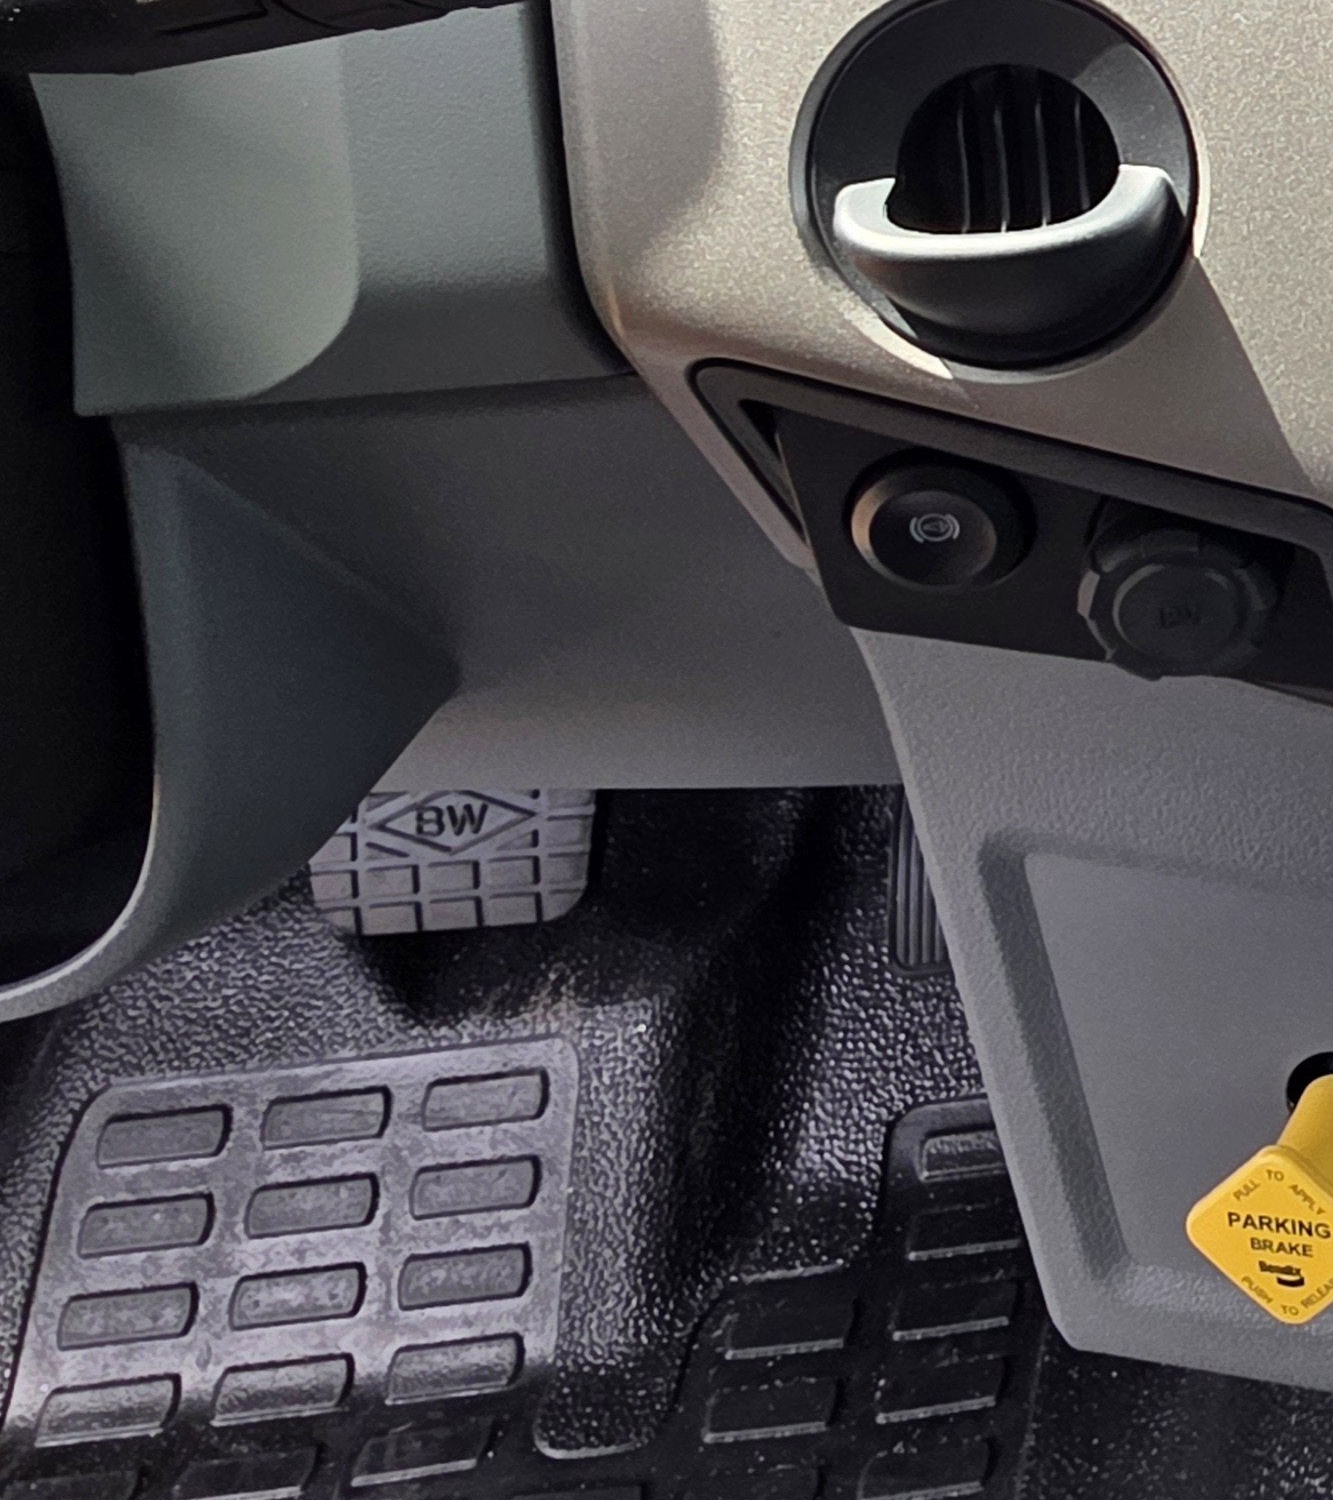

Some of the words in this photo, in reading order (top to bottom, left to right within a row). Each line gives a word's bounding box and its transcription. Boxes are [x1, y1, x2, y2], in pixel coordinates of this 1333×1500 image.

[415, 802, 489, 837] BW
[1232, 1179, 1261, 1202] PULL
[1265, 1168, 1285, 1182] TO
[1227, 1211, 1332, 1240] PARKING
[1249, 1237, 1314, 1258] BRAKE
[1280, 1304, 1300, 1317] TO
